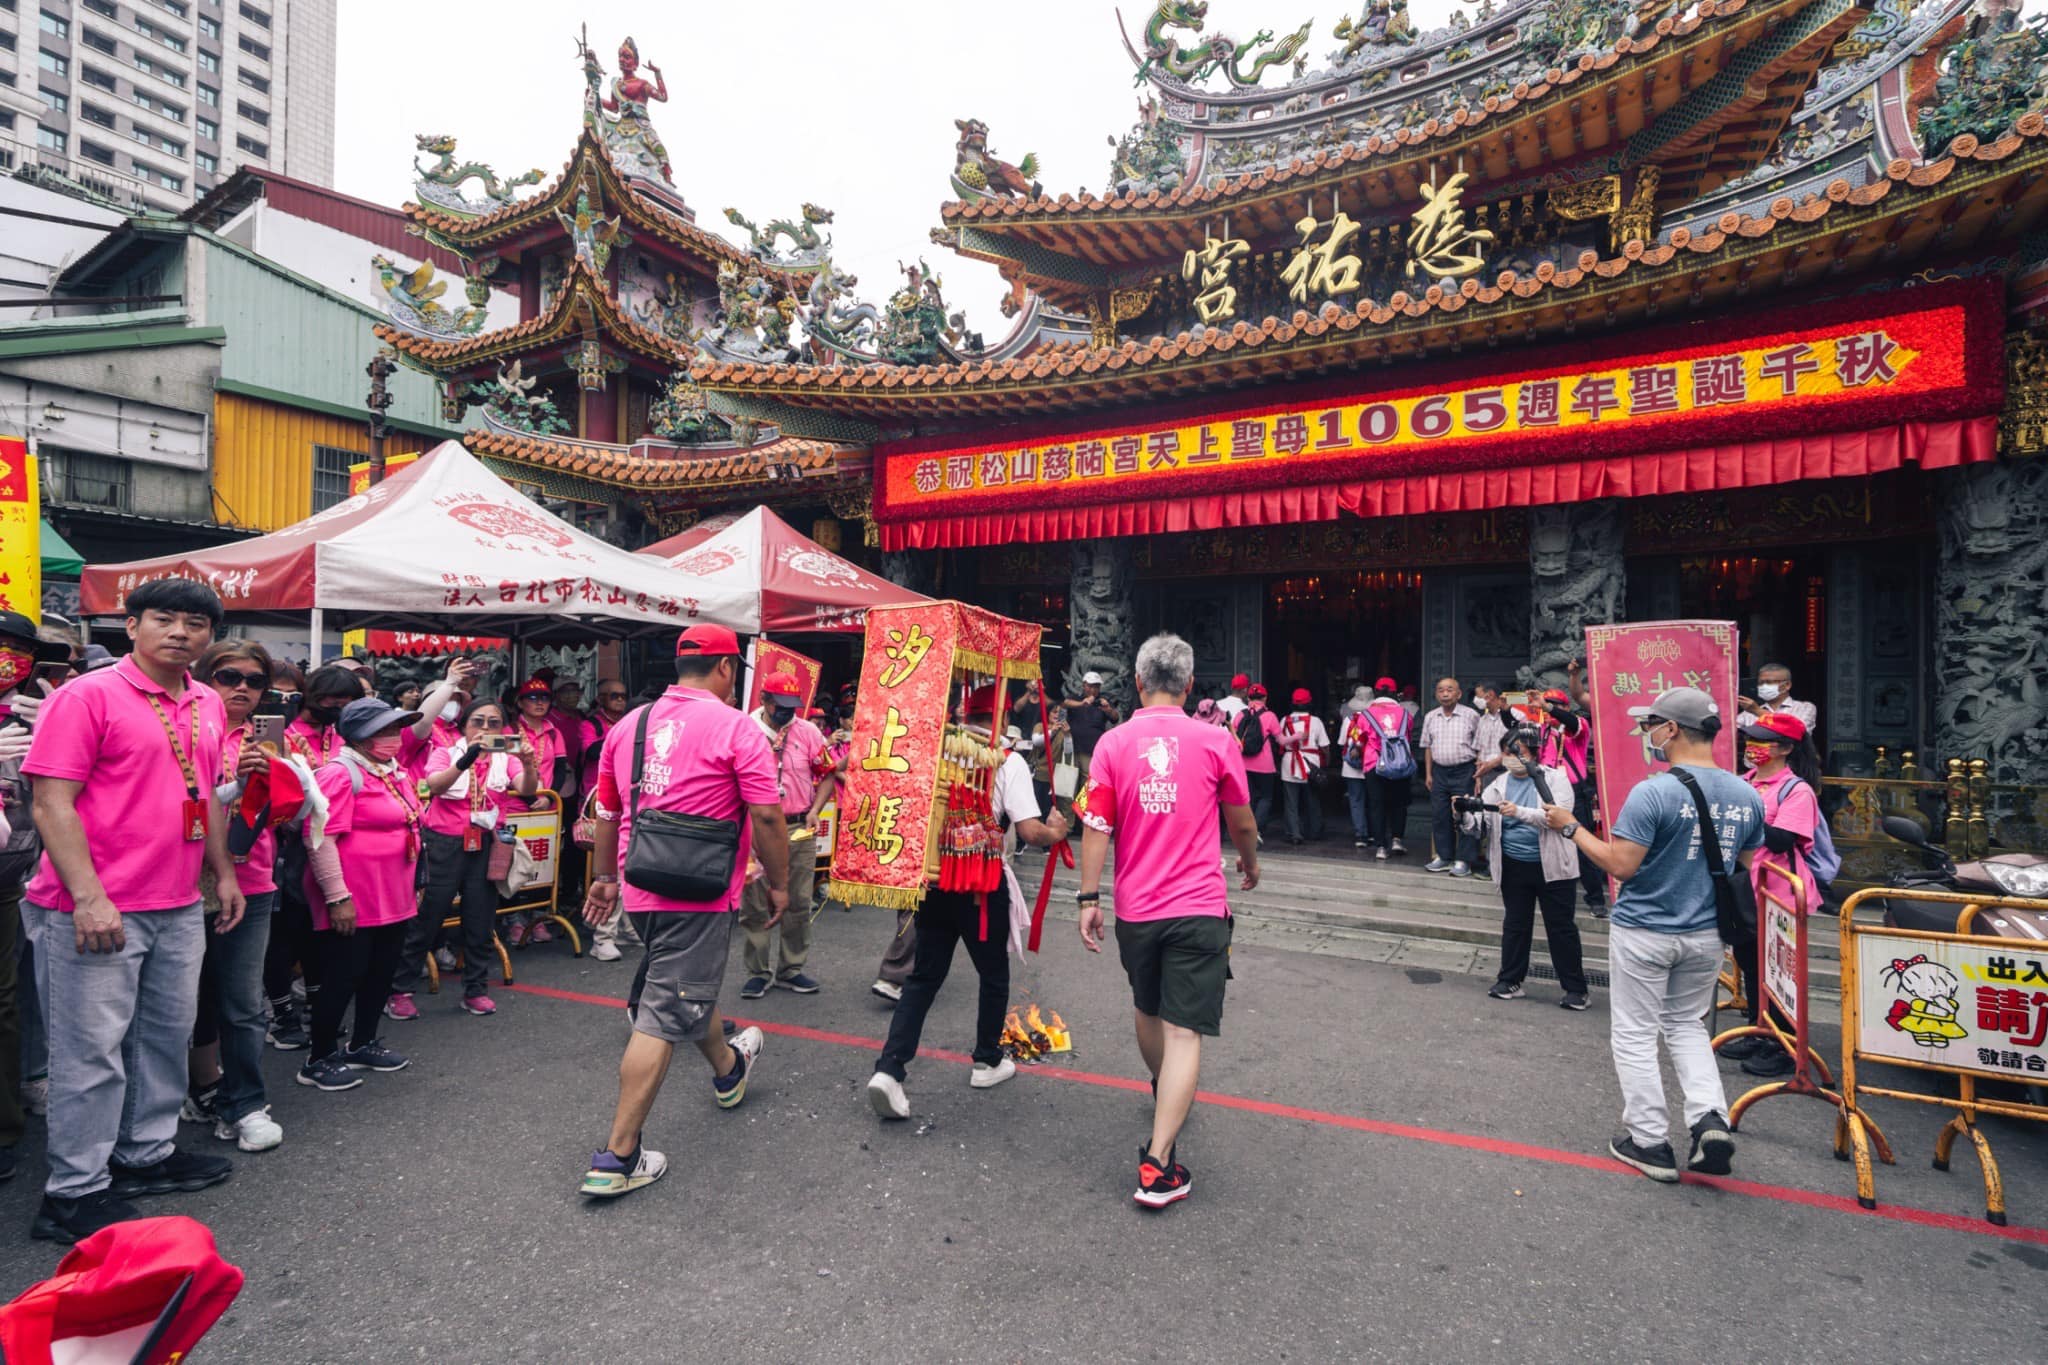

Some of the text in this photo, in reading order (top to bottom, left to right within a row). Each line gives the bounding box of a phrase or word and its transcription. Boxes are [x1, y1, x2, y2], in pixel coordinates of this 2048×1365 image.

[914, 332, 1902, 494] 恭祝松山慈祐宮天上聖母1065週年聖誕千秋
[849, 624, 934, 865] 汐止媽
[1139, 782, 1177, 793] MAZU
[1139, 793, 1177, 802] BLESS
